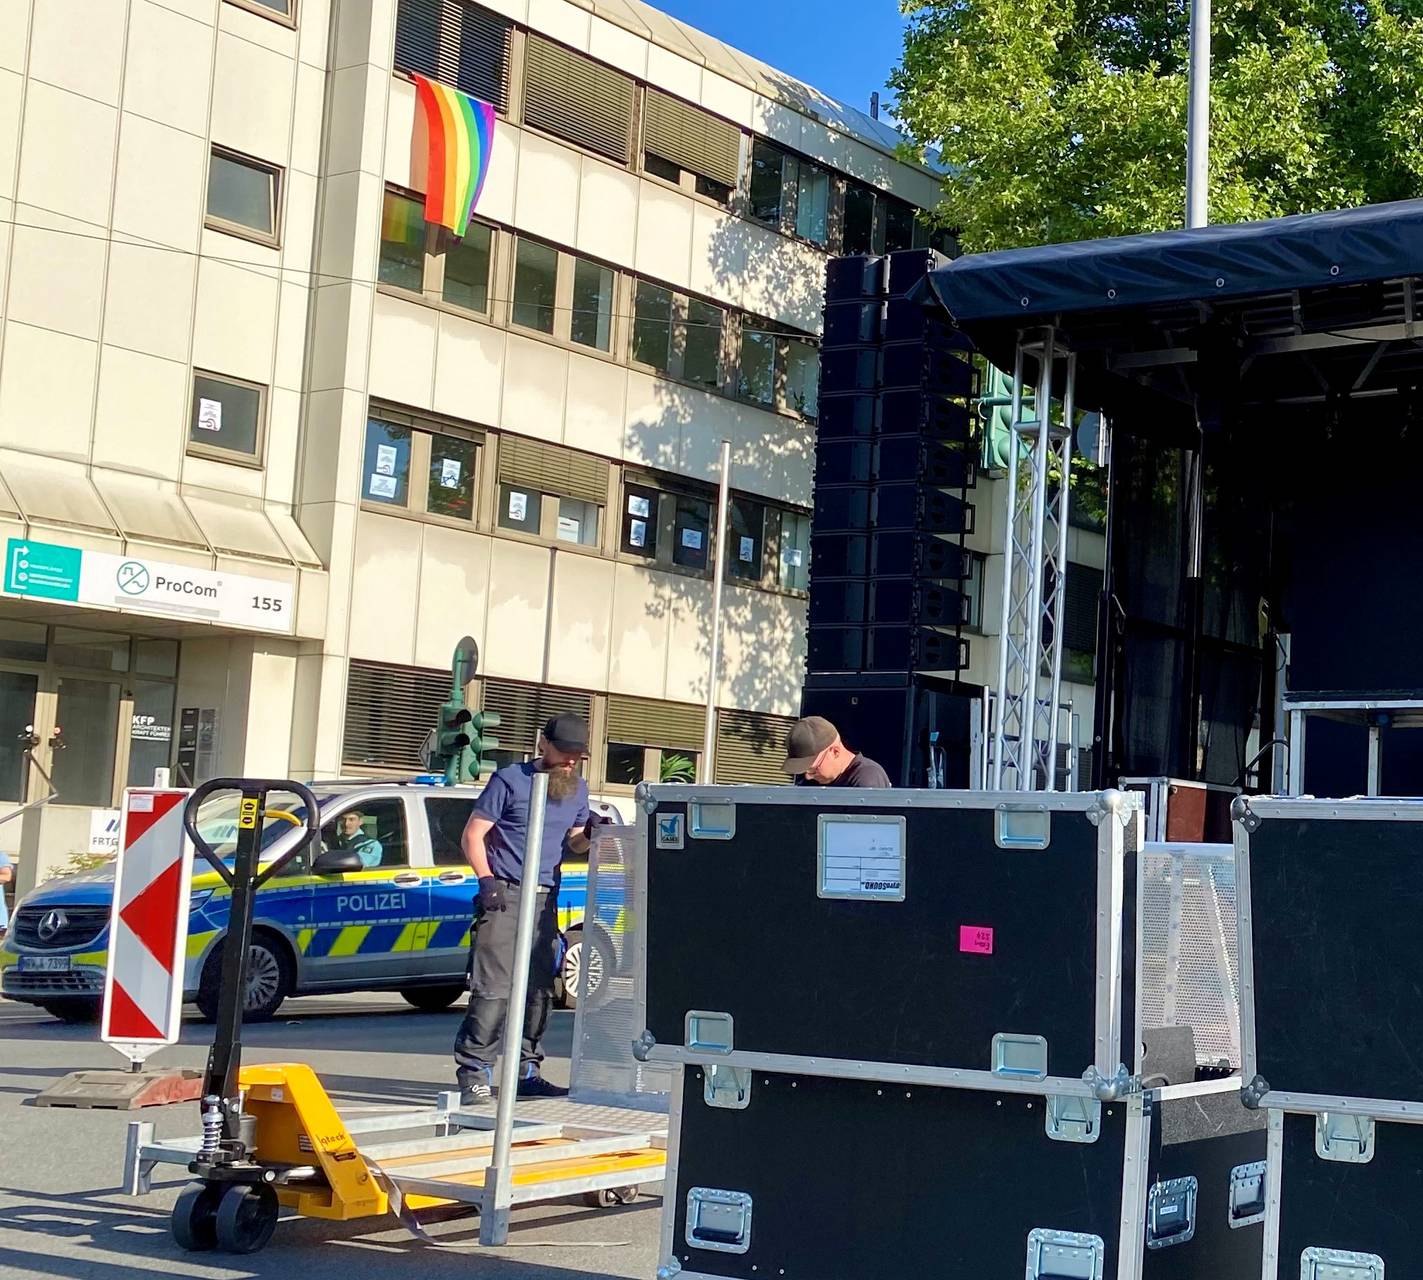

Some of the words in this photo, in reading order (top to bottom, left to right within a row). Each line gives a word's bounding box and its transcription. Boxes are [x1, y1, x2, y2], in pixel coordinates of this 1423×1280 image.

[156, 577, 217, 598] ProCom
[252, 596, 283, 612] 155
[132, 714, 155, 726] KFP
[337, 893, 406, 912] POLIZEI
